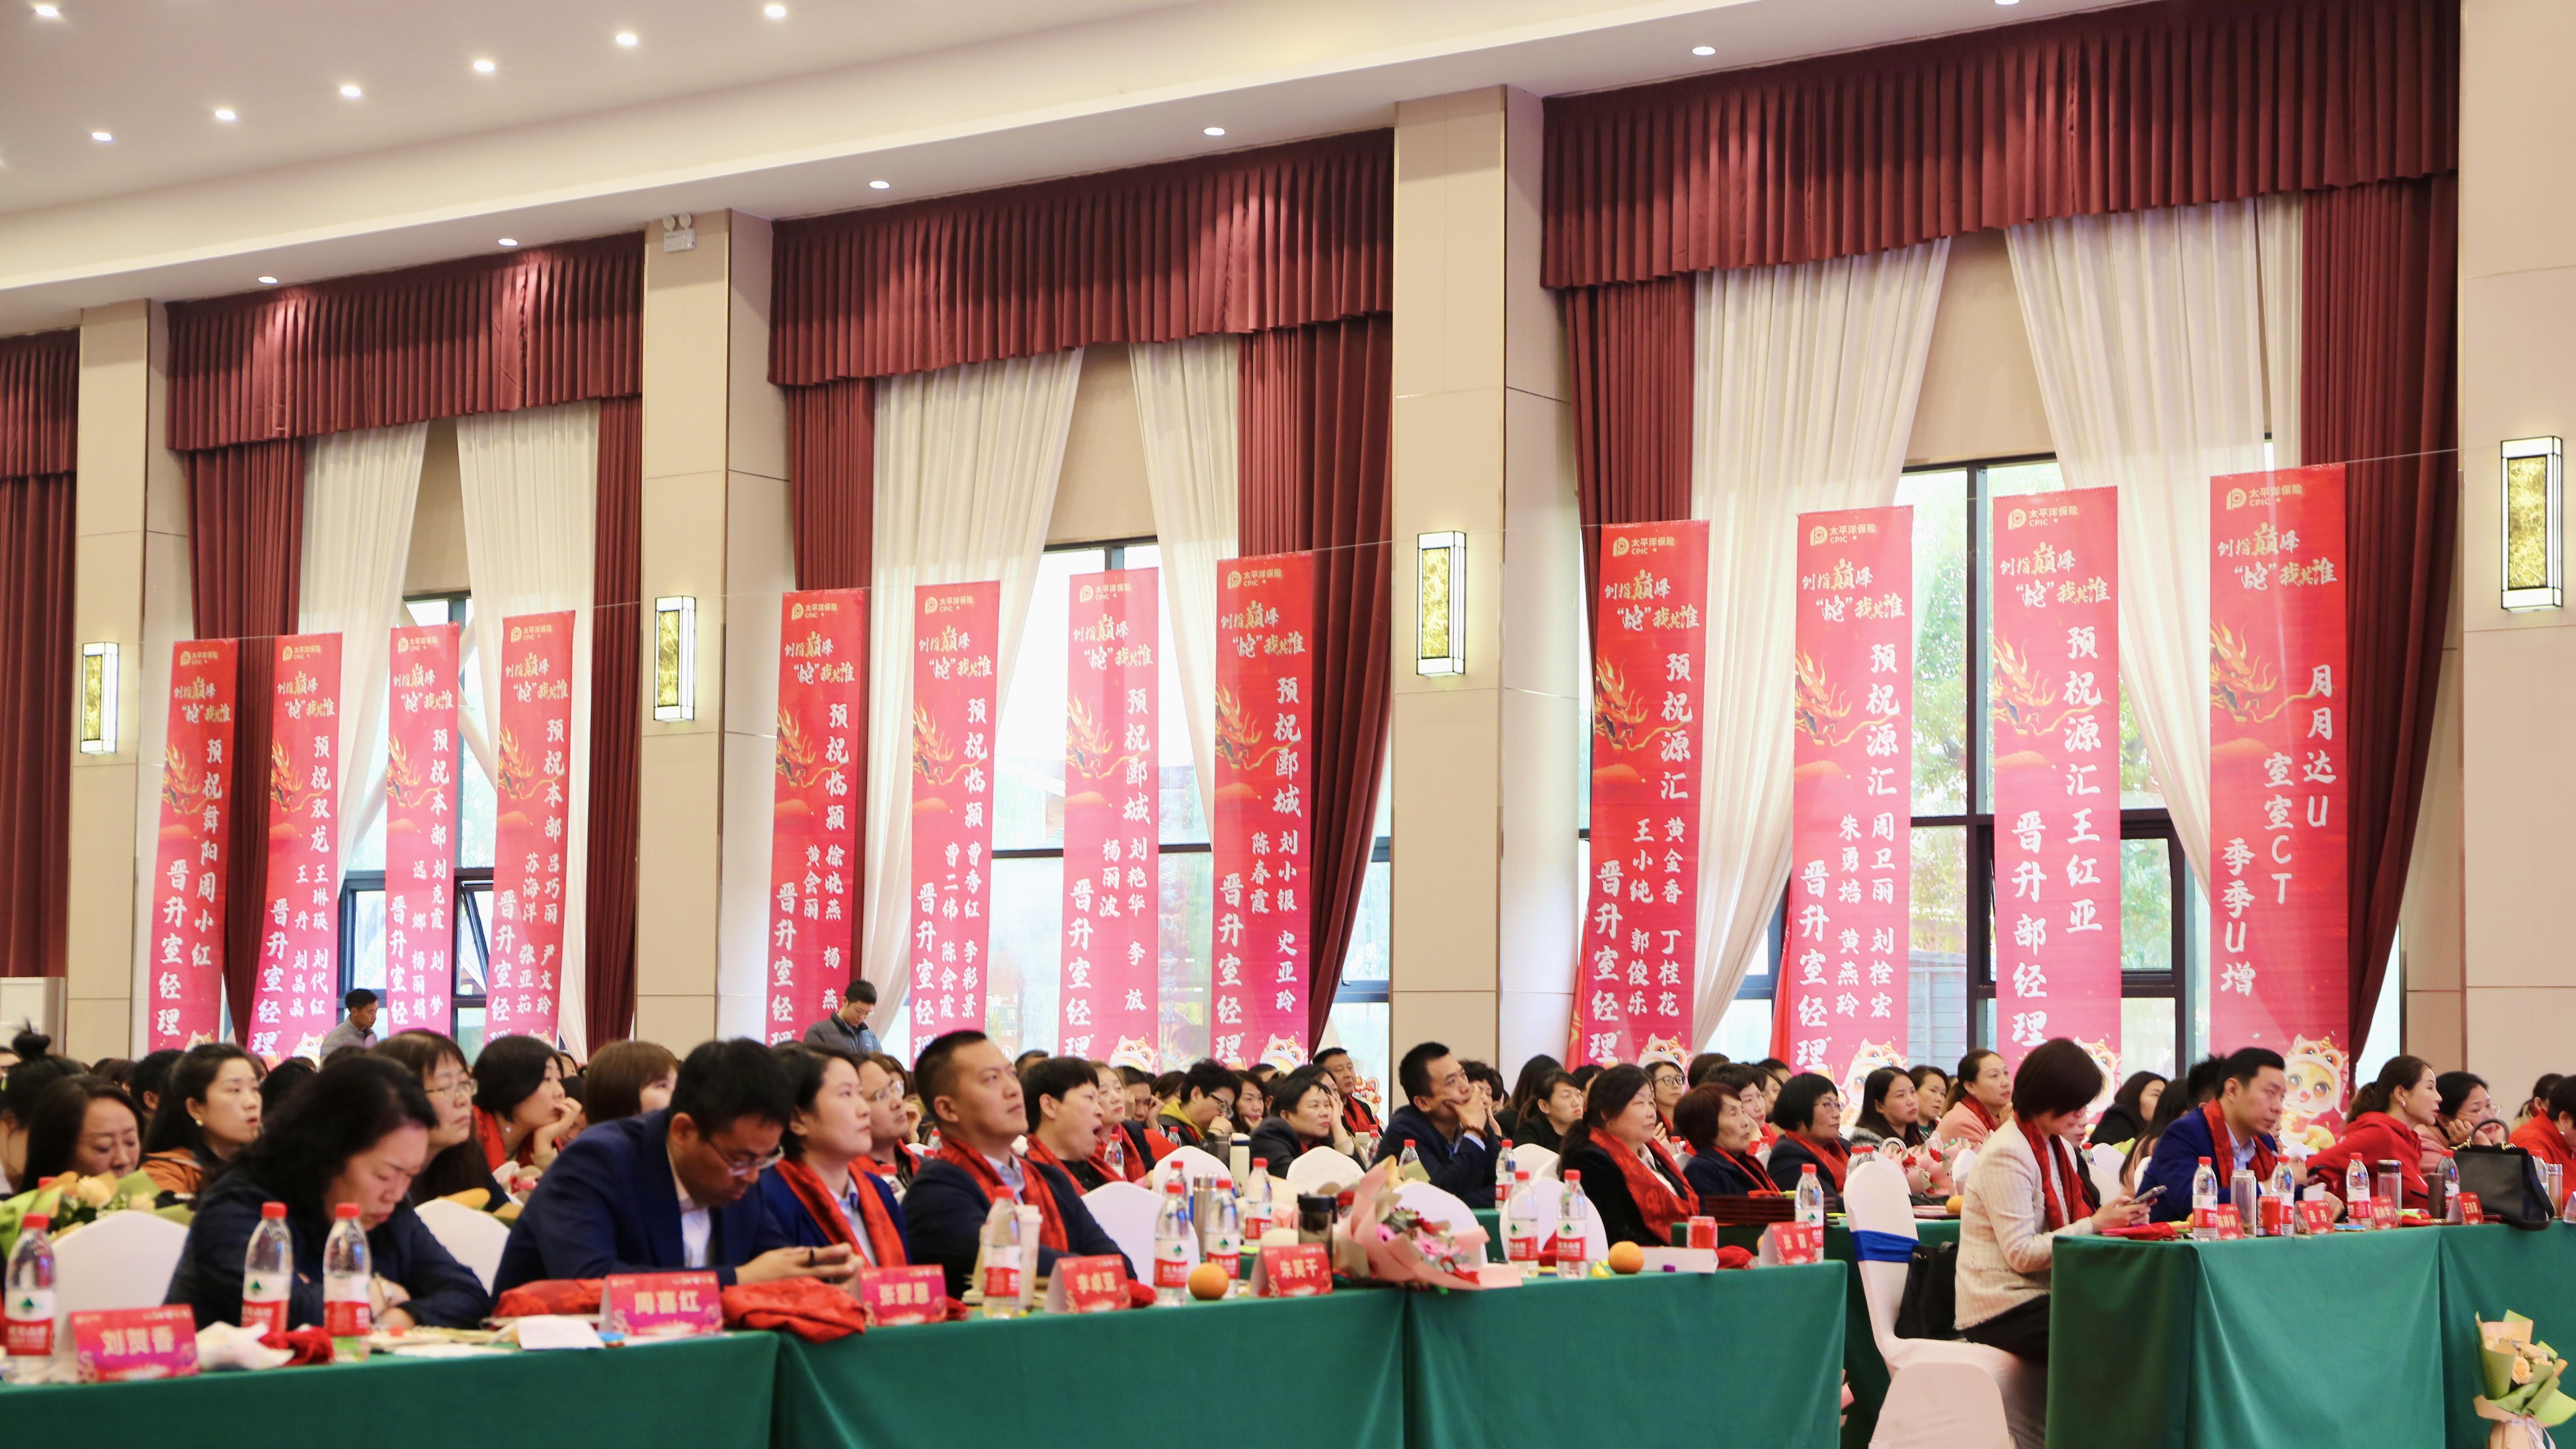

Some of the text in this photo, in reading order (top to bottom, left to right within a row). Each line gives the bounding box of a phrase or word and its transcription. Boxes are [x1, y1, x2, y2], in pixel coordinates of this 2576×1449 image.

[2249, 484, 2303, 498] 太平洋保险
[2249, 498, 2271, 507] CPIC
[2029, 506, 2079, 518] 太平洋保险
[2029, 518, 2049, 527] CPIC
[1830, 523, 1877, 536] 太平洋保险
[1631, 536, 1675, 548] 太平洋保险
[1830, 535, 1848, 544] CPIC
[1631, 547, 1648, 556] CPIC
[1243, 568, 1282, 580] 太平洋保险
[1095, 583, 1131, 593] 太平洋保险
[939, 595, 974, 606] 太平洋保险
[805, 602, 838, 613] 太平洋保险
[523, 625, 553, 634] 太平洋保险
[409, 636, 438, 645] 太平洋保险
[2063, 626, 2103, 934] 预祝源汇王红亚
[2011, 811, 2049, 1047] 晋升部经理
[157, 859, 190, 1036] 晋升室经理
[488, 889, 517, 1042] 晋升室经
[1589, 860, 1625, 1063] 晋升室经理
[1796, 860, 1831, 1071] 晋升室经理
[1064, 878, 1095, 1059] 晋升室经理
[1215, 873, 1245, 1066] 晋升室经理
[251, 898, 290, 1057] 晋升室经理
